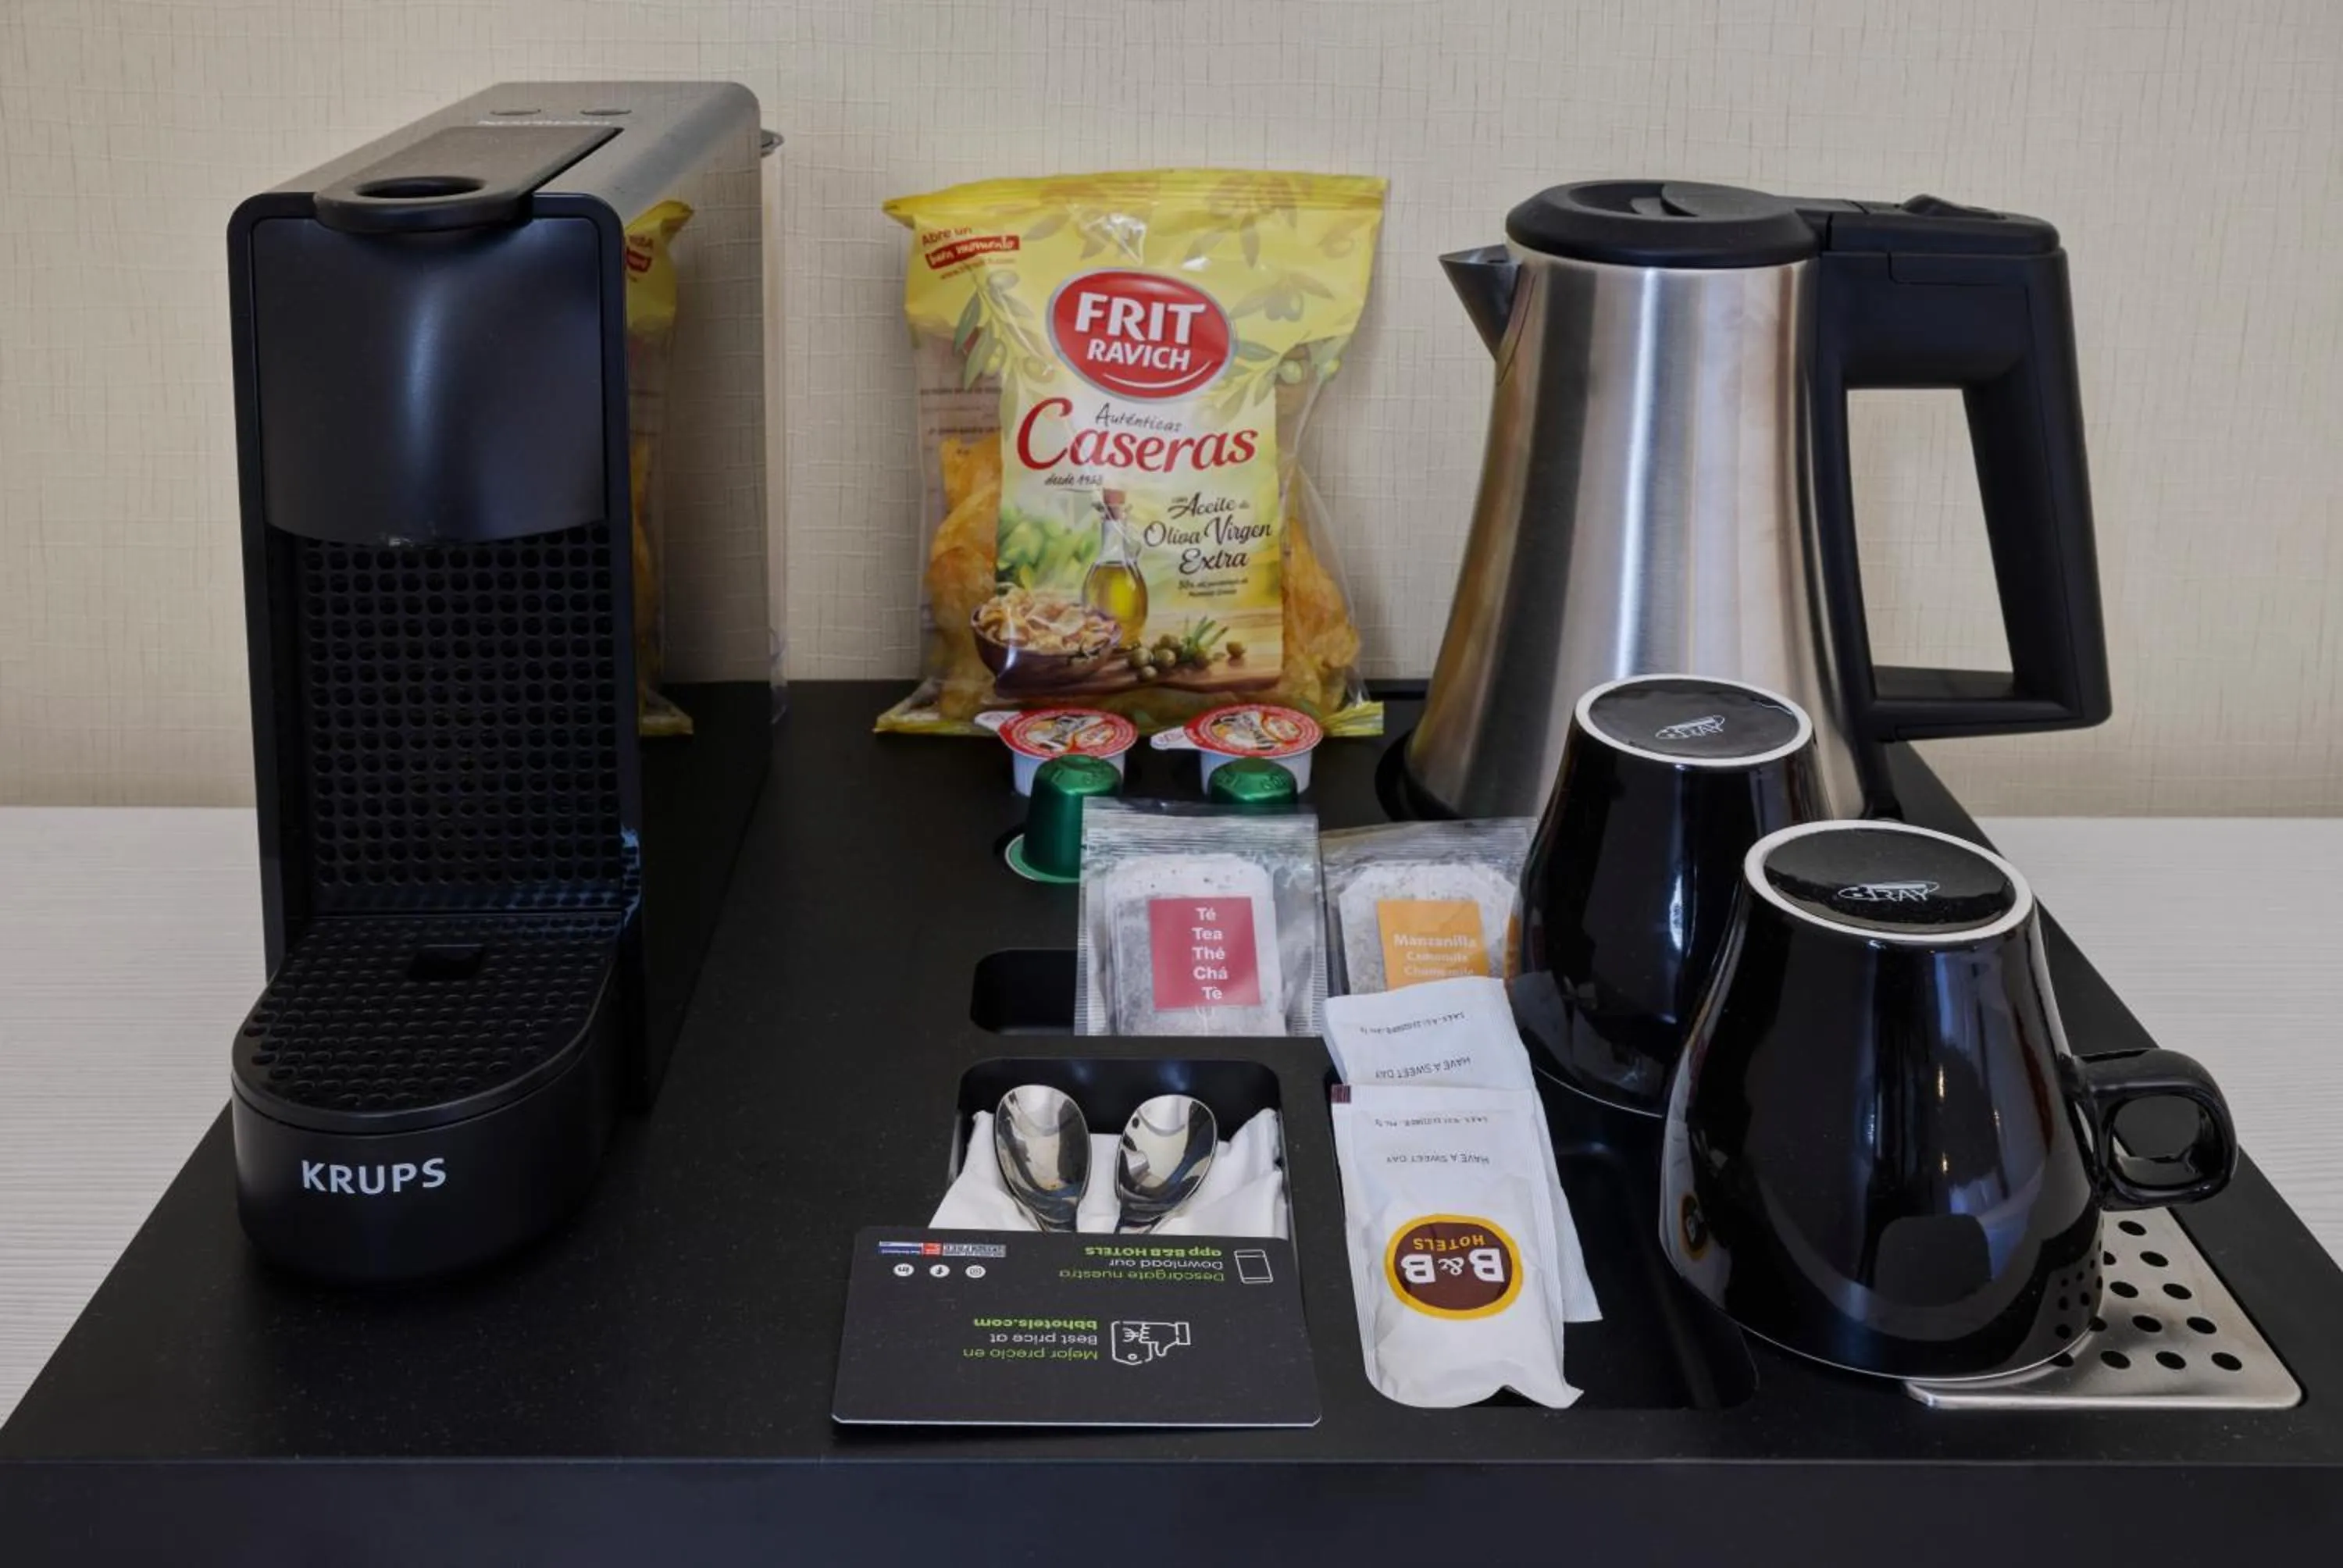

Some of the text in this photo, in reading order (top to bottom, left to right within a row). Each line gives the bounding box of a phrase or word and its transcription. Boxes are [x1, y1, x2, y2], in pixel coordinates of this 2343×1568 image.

[1075, 292, 1207, 344] FRIT
[1087, 338, 1191, 371] RAVICH
[1096, 402, 1182, 432] Auténticas
[1017, 397, 1258, 472] Caseras
[1168, 492, 1236, 519] Aceite
[1144, 515, 1272, 547] Oliva Virgen
[1179, 548, 1248, 575] Extra
[1192, 927, 1222, 940] Tea
[1394, 934, 1477, 947] Manzanilla
[1193, 967, 1228, 980] Chá
[1376, 1056, 1471, 1078] HAVE A SWEET DAY
[1411, 1154, 1447, 1163] SWEET
[1450, 1153, 1457, 1162] A
[1461, 1153, 1489, 1164] HAVE
[301, 1157, 447, 1194] KRUPS
[1413, 1235, 1485, 1250] HOTELS
[1085, 1247, 1222, 1257] app B&B HOTELS
[1140, 1259, 1223, 1270] Download
[1401, 1248, 1505, 1283] B&B
[1059, 1270, 1122, 1279] nuestra
[974, 1318, 1097, 1331] bbhotels.com
[990, 1333, 1097, 1345] Best price at
[963, 1347, 1098, 1361] Mejor precio en
